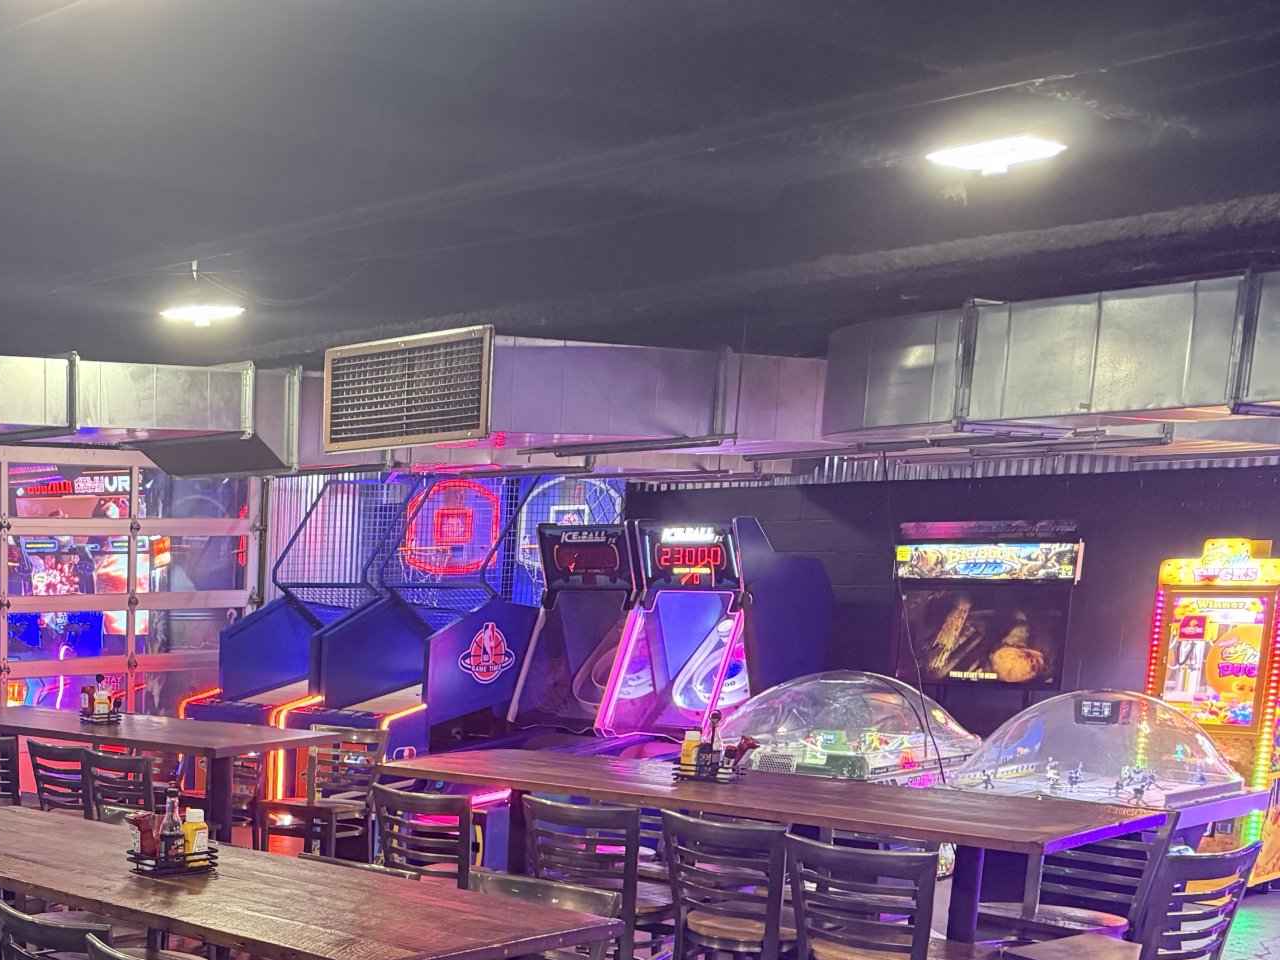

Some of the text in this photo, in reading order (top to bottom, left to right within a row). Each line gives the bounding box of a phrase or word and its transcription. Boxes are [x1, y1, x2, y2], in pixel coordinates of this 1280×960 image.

[104, 475, 130, 492] VR
[660, 546, 721, 566] 23000
[947, 546, 1021, 563] BIG BUCK
[1193, 567, 1258, 582] DUCKS
[1196, 599, 1246, 610] Winner
[472, 664, 503, 673] GAME TIME
